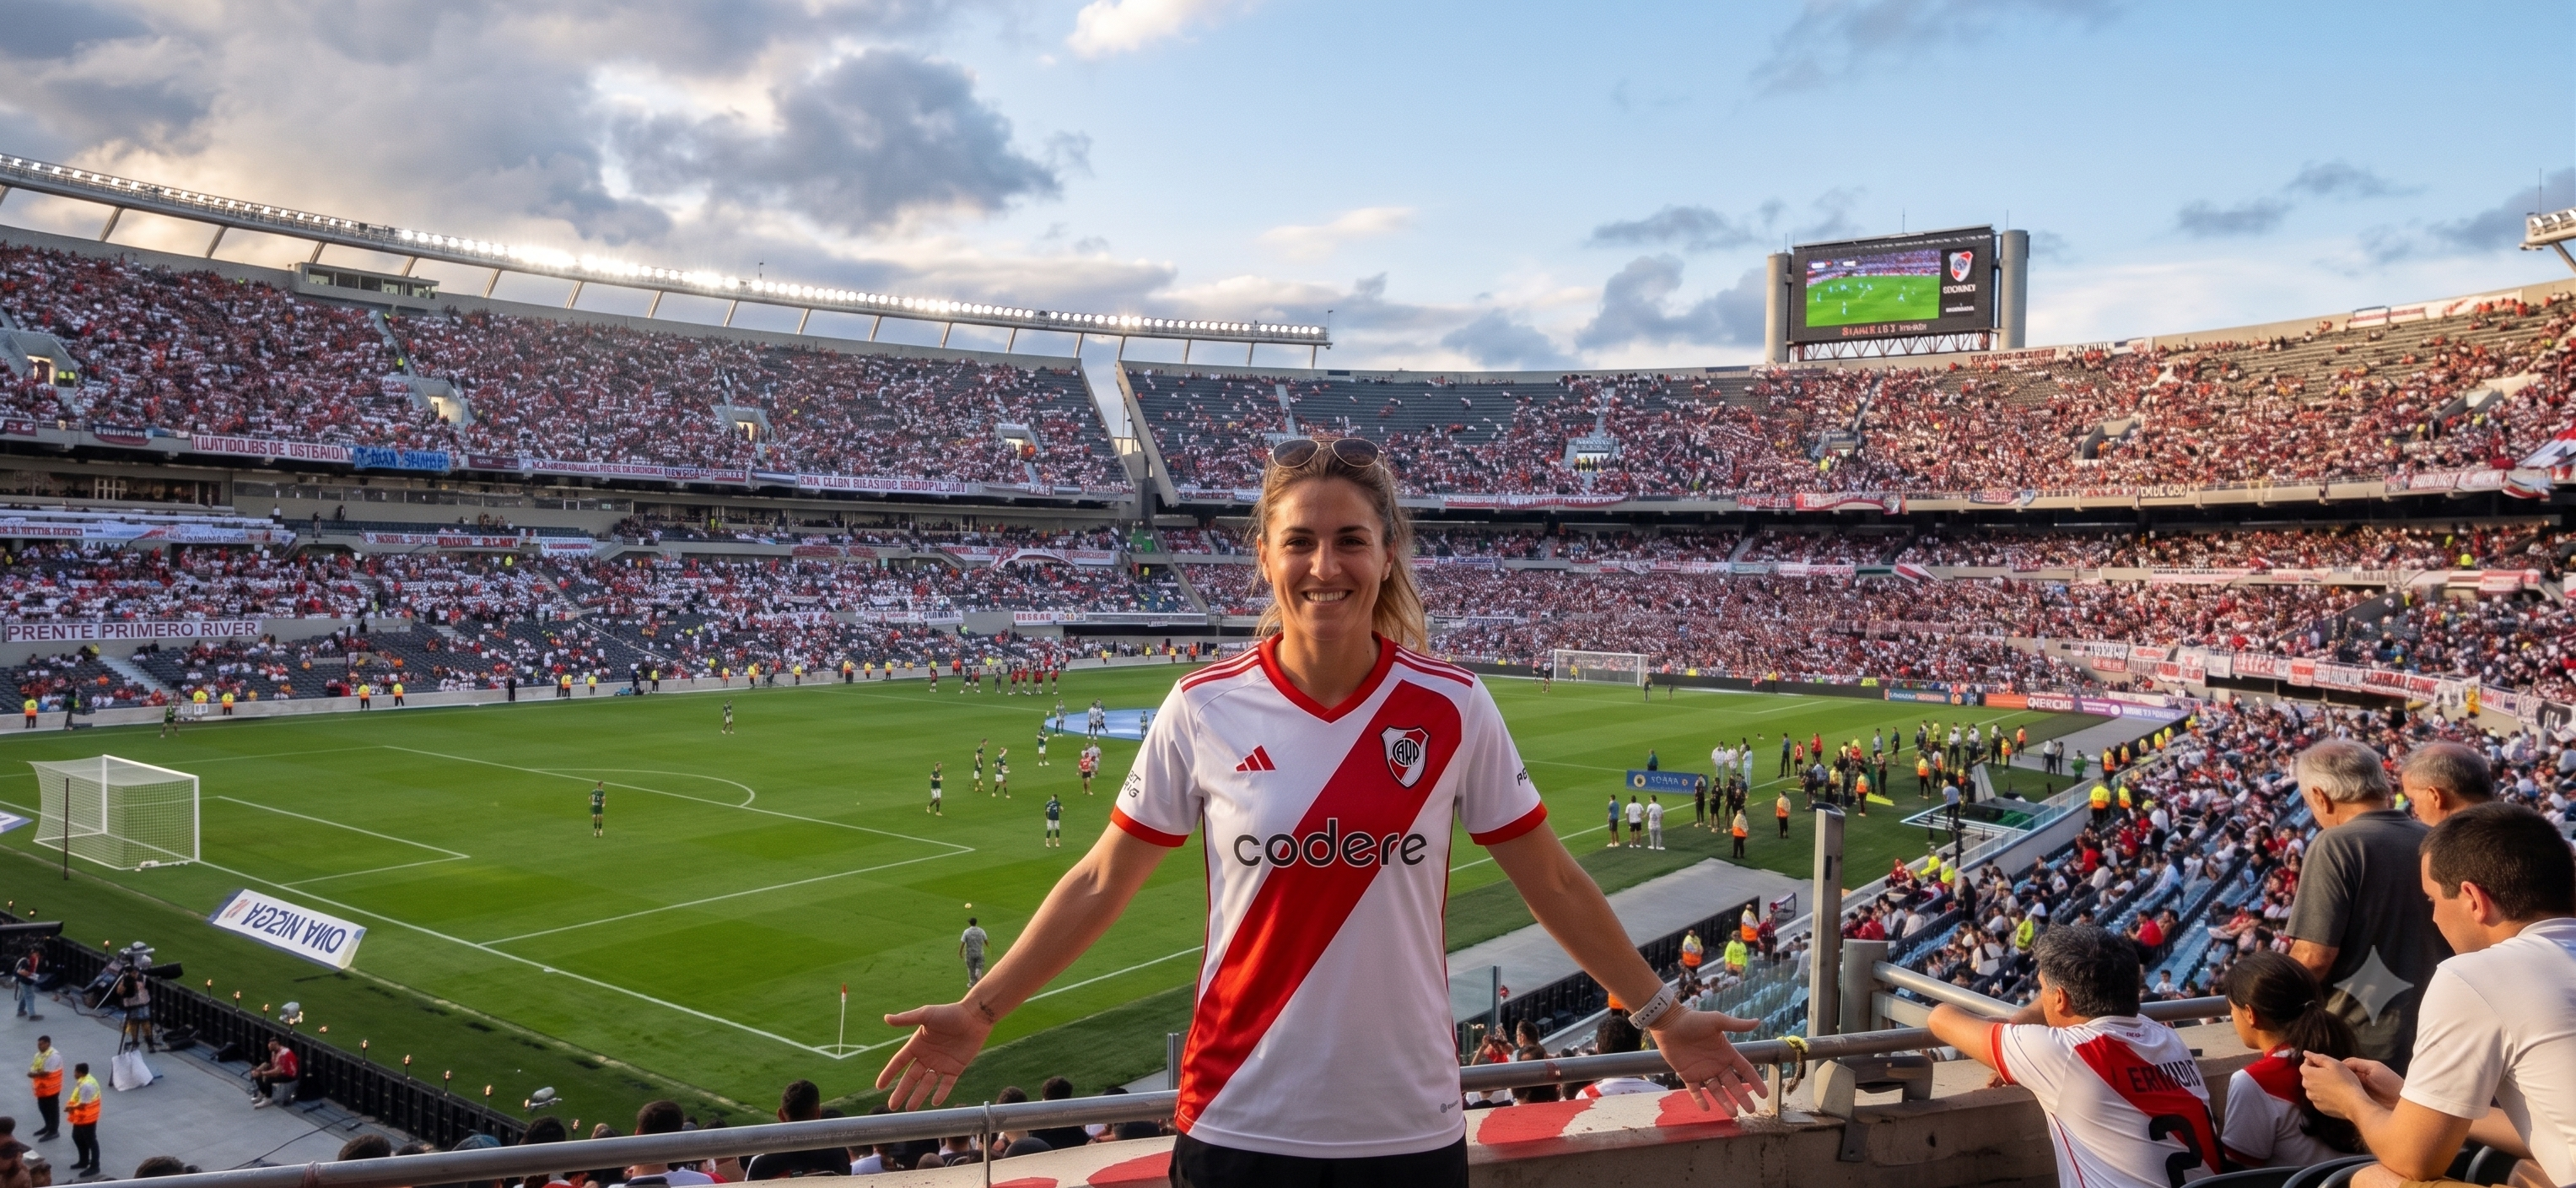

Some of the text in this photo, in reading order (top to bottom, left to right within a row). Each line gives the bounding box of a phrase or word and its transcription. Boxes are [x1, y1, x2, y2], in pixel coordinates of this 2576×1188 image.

[7, 622, 257, 641] PRENTE PRIMERO RIVER
[1233, 818, 1428, 867] codere
[2148, 1114, 2203, 1188] 2
